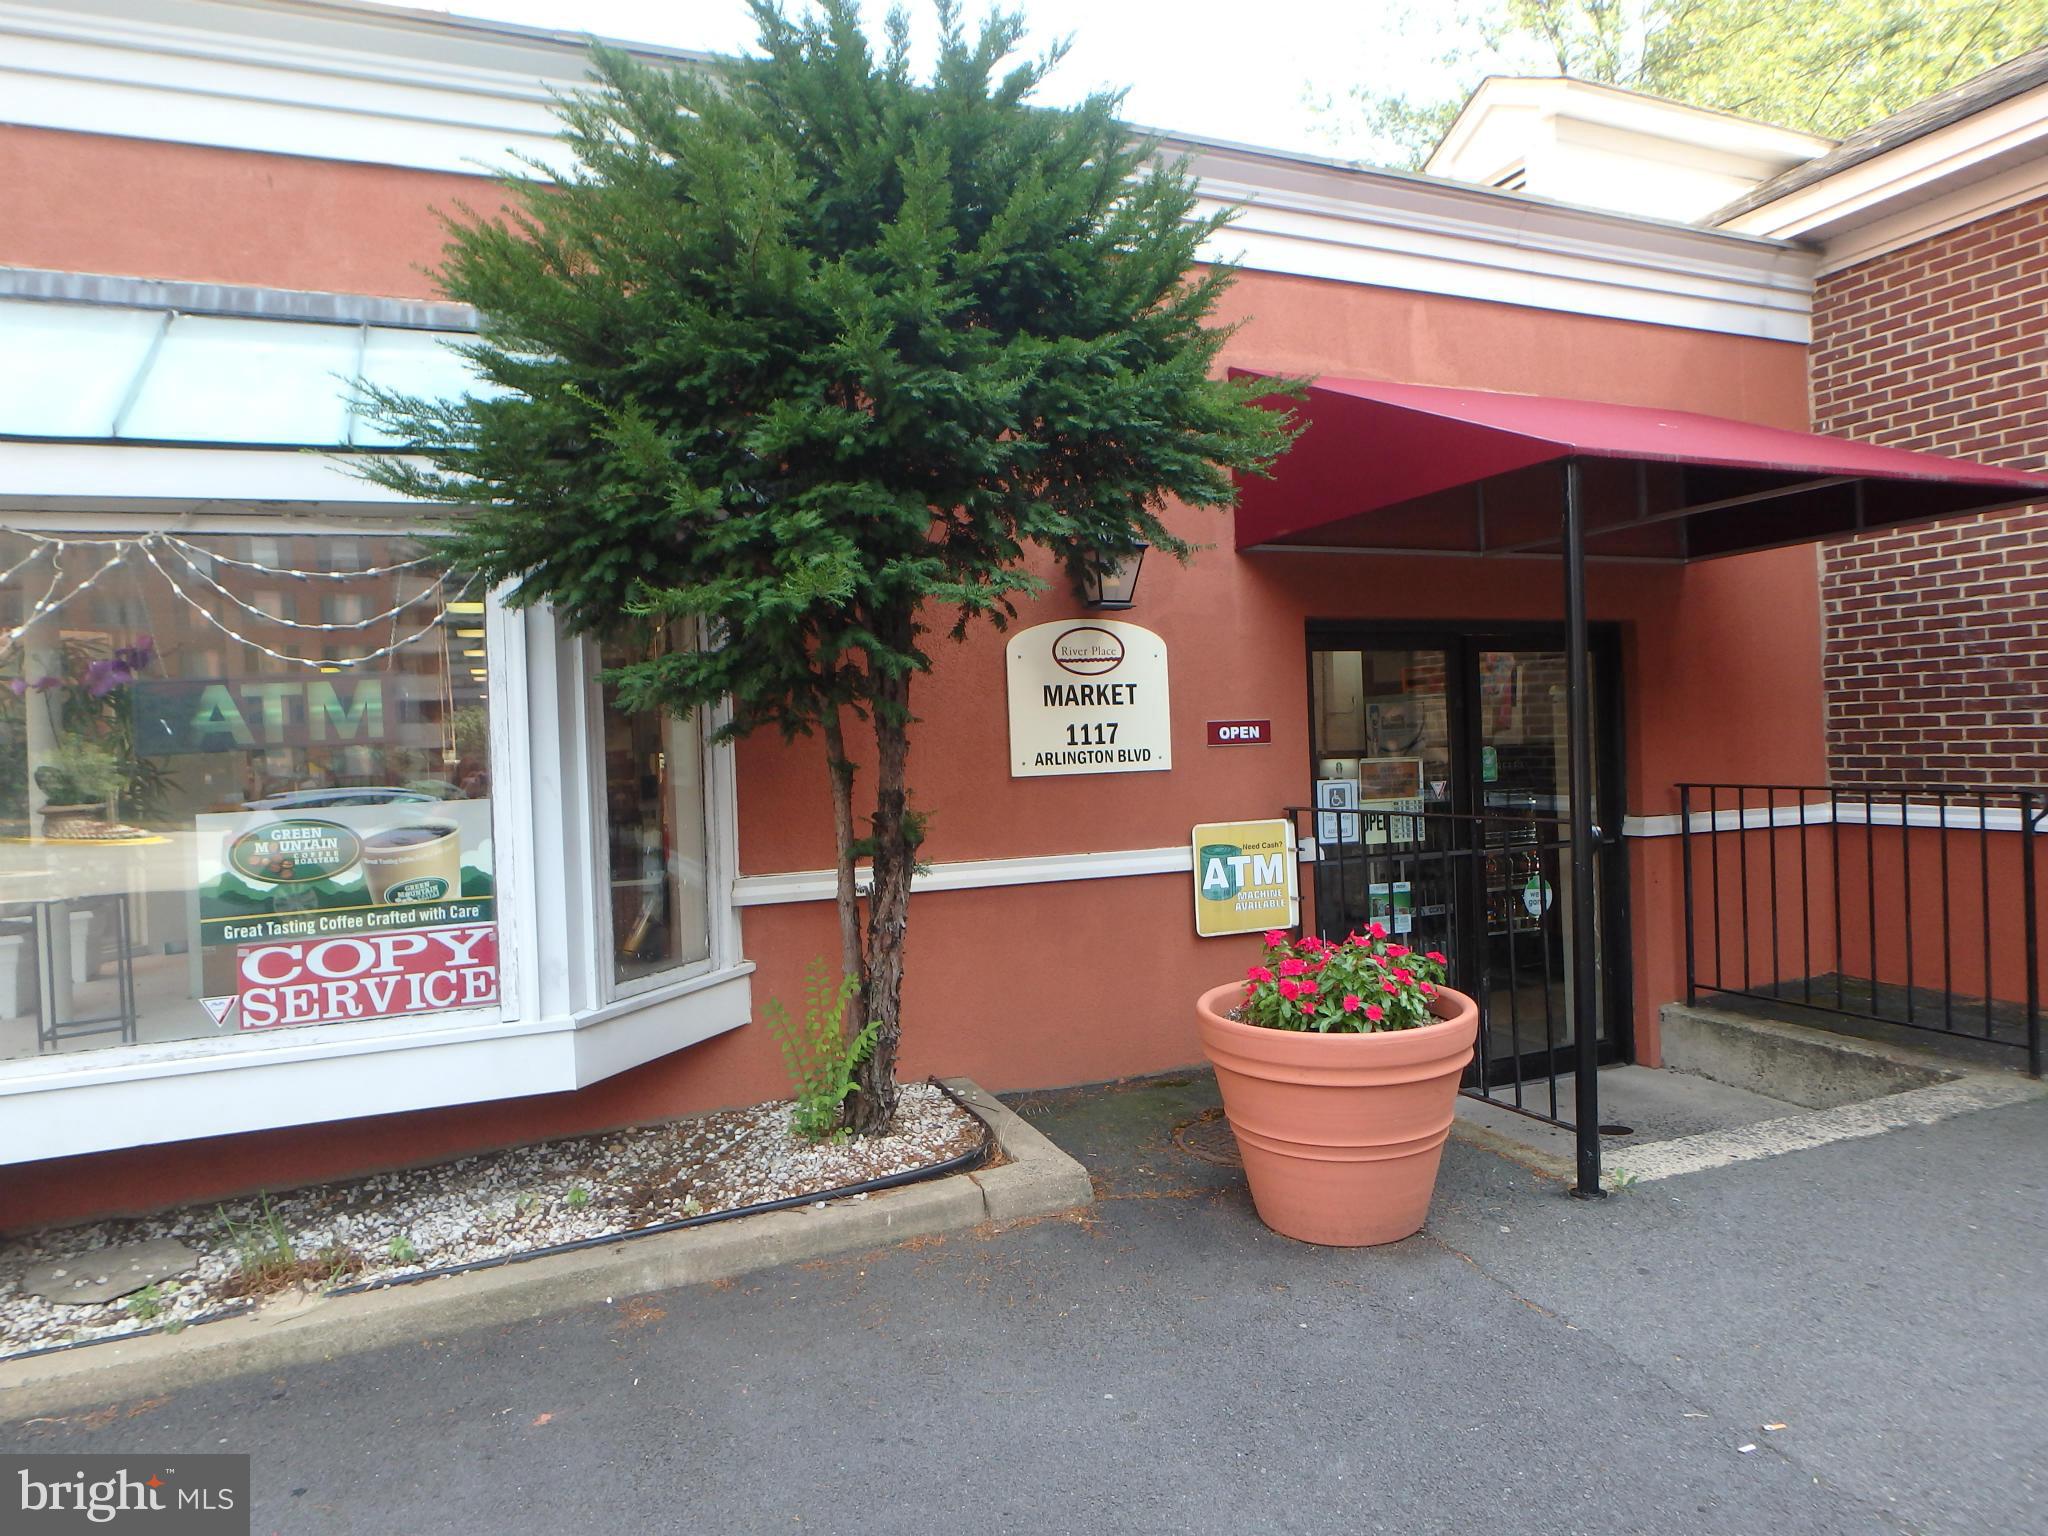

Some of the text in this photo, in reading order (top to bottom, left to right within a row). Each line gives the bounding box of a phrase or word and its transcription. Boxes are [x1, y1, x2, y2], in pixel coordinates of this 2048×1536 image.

[1061, 645, 1117, 656] River Place
[1043, 683, 1137, 707] MARKET
[190, 679, 385, 744] ATM
[1066, 722, 1119, 746] 1117
[1218, 725, 1260, 740] OPEN
[1034, 748, 1151, 766] ARLINGTON BLVD
[271, 827, 322, 841] GREEN
[254, 837, 339, 855] MOUNTAIN
[1242, 841, 1283, 851] Need Cash?
[293, 851, 339, 859] COFFEE
[294, 857, 340, 866] ROASTERS
[1202, 853, 1285, 890] ATM
[404, 881, 431, 892] GREEN
[1237, 890, 1283, 901] MACHINE
[1235, 899, 1286, 912] AVAILABLE
[224, 905, 480, 940] Great Tasting Coffee Crafted with Care
[241, 927, 494, 985] COPY
[242, 966, 497, 1028] SERVICE
